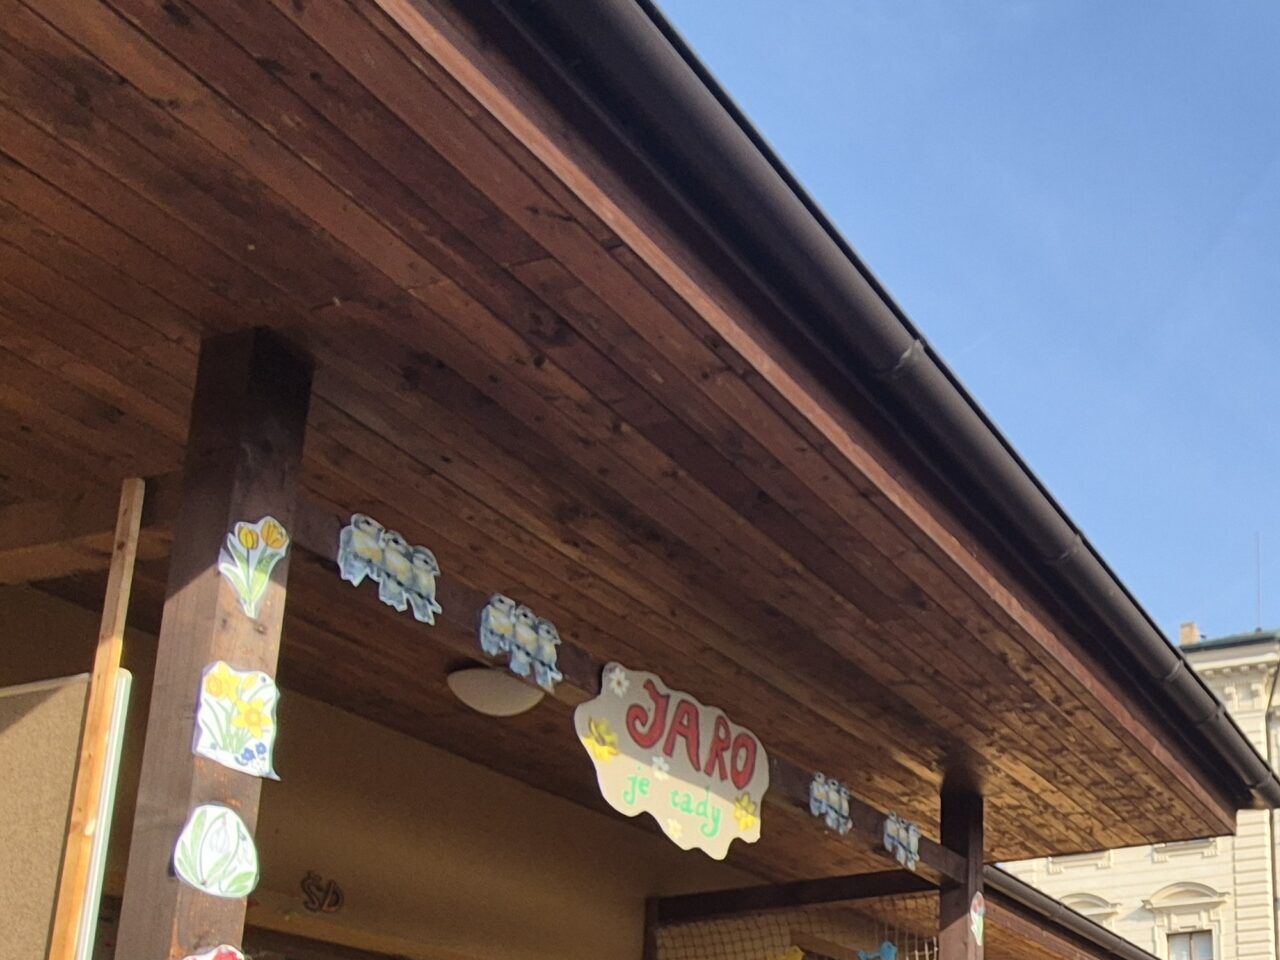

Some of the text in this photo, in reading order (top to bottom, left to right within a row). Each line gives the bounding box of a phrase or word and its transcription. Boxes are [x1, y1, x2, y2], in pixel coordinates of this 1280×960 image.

[626, 678, 757, 790] JARO
[623, 767, 722, 837] je tady
